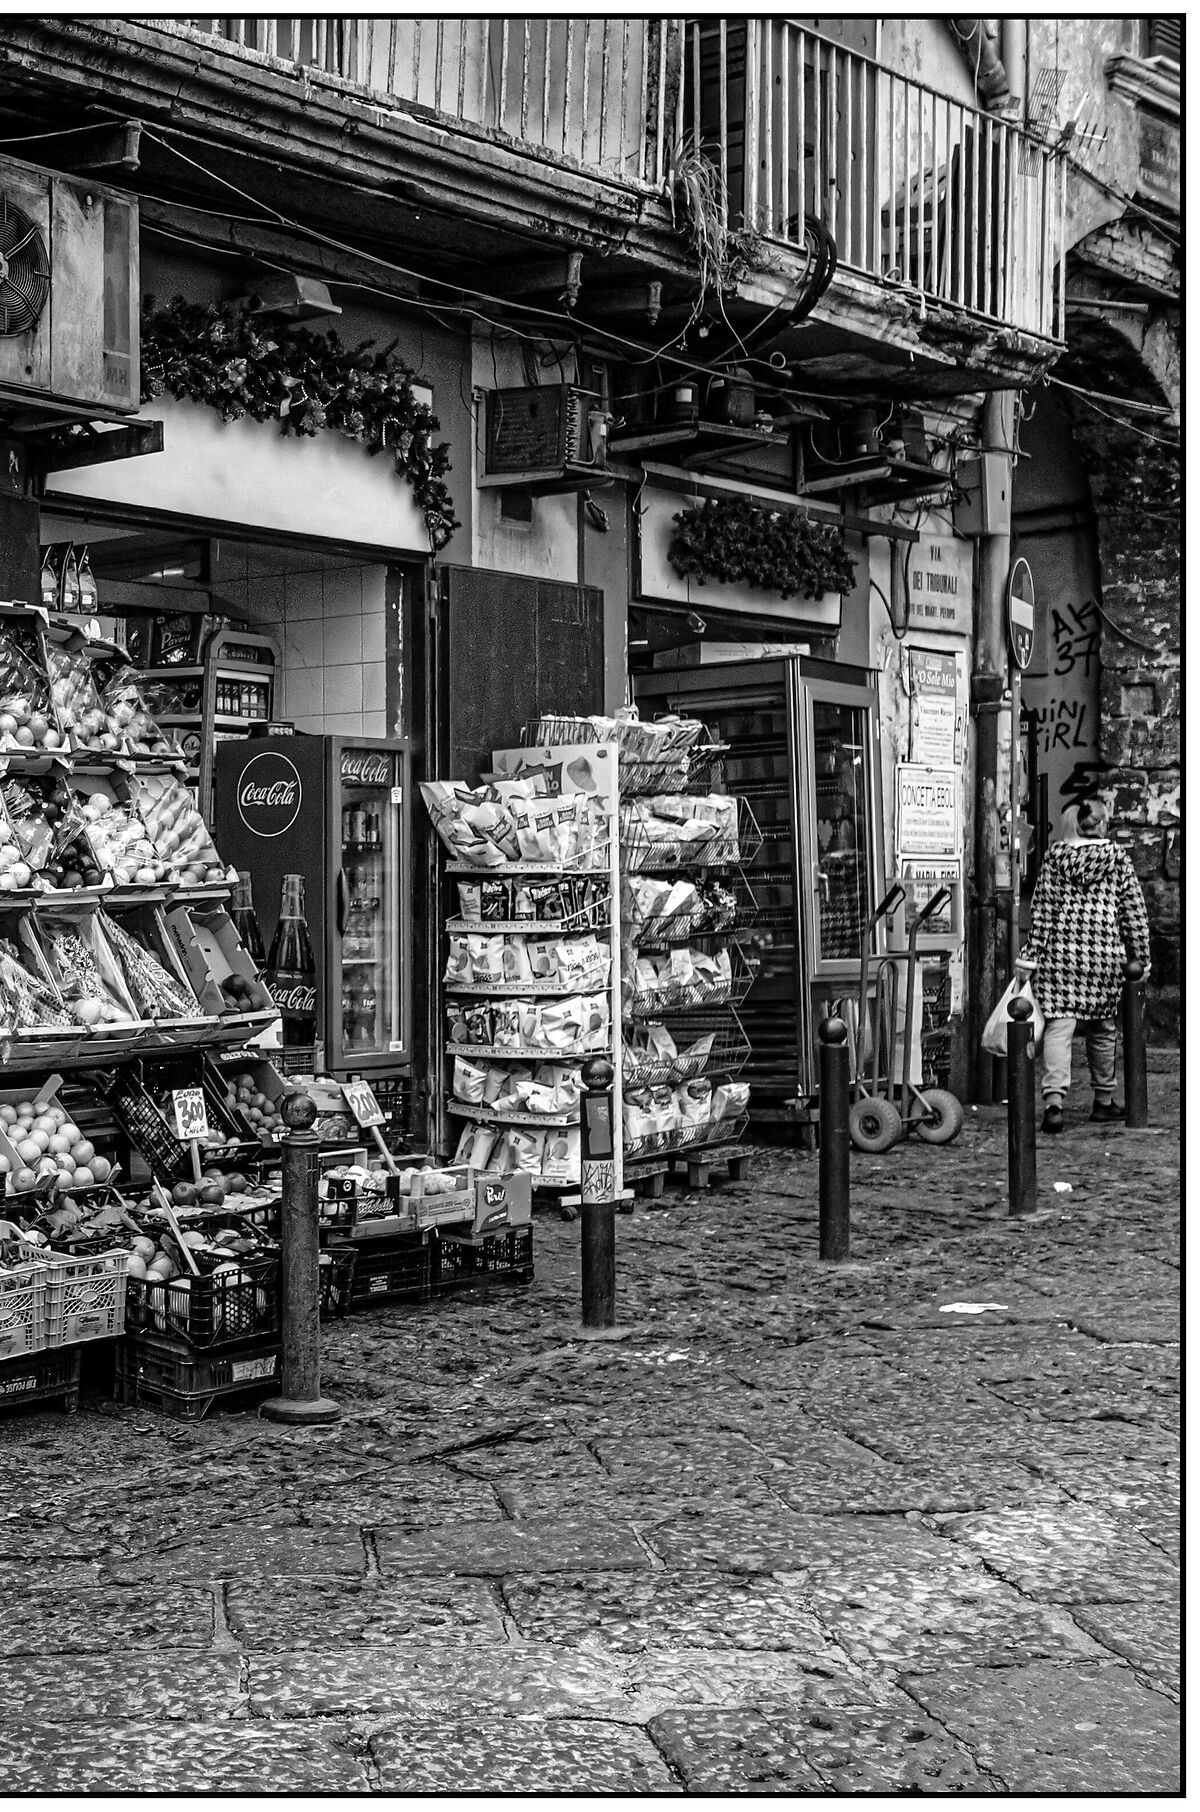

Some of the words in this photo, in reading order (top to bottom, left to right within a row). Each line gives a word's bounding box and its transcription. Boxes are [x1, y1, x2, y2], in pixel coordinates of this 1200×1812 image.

[930, 545, 941, 562] VIA
[913, 571, 922, 590] DEI
[927, 572, 958, 595] TRIBUNALI
[1054, 631, 1098, 677] 37
[942, 673, 955, 688] Mio
[341, 752, 390, 783] Coca-Cola
[241, 780, 298, 806] Coca-Cola
[902, 785, 936, 807] CONCETTA
[267, 983, 317, 1012] Coca-Cola
